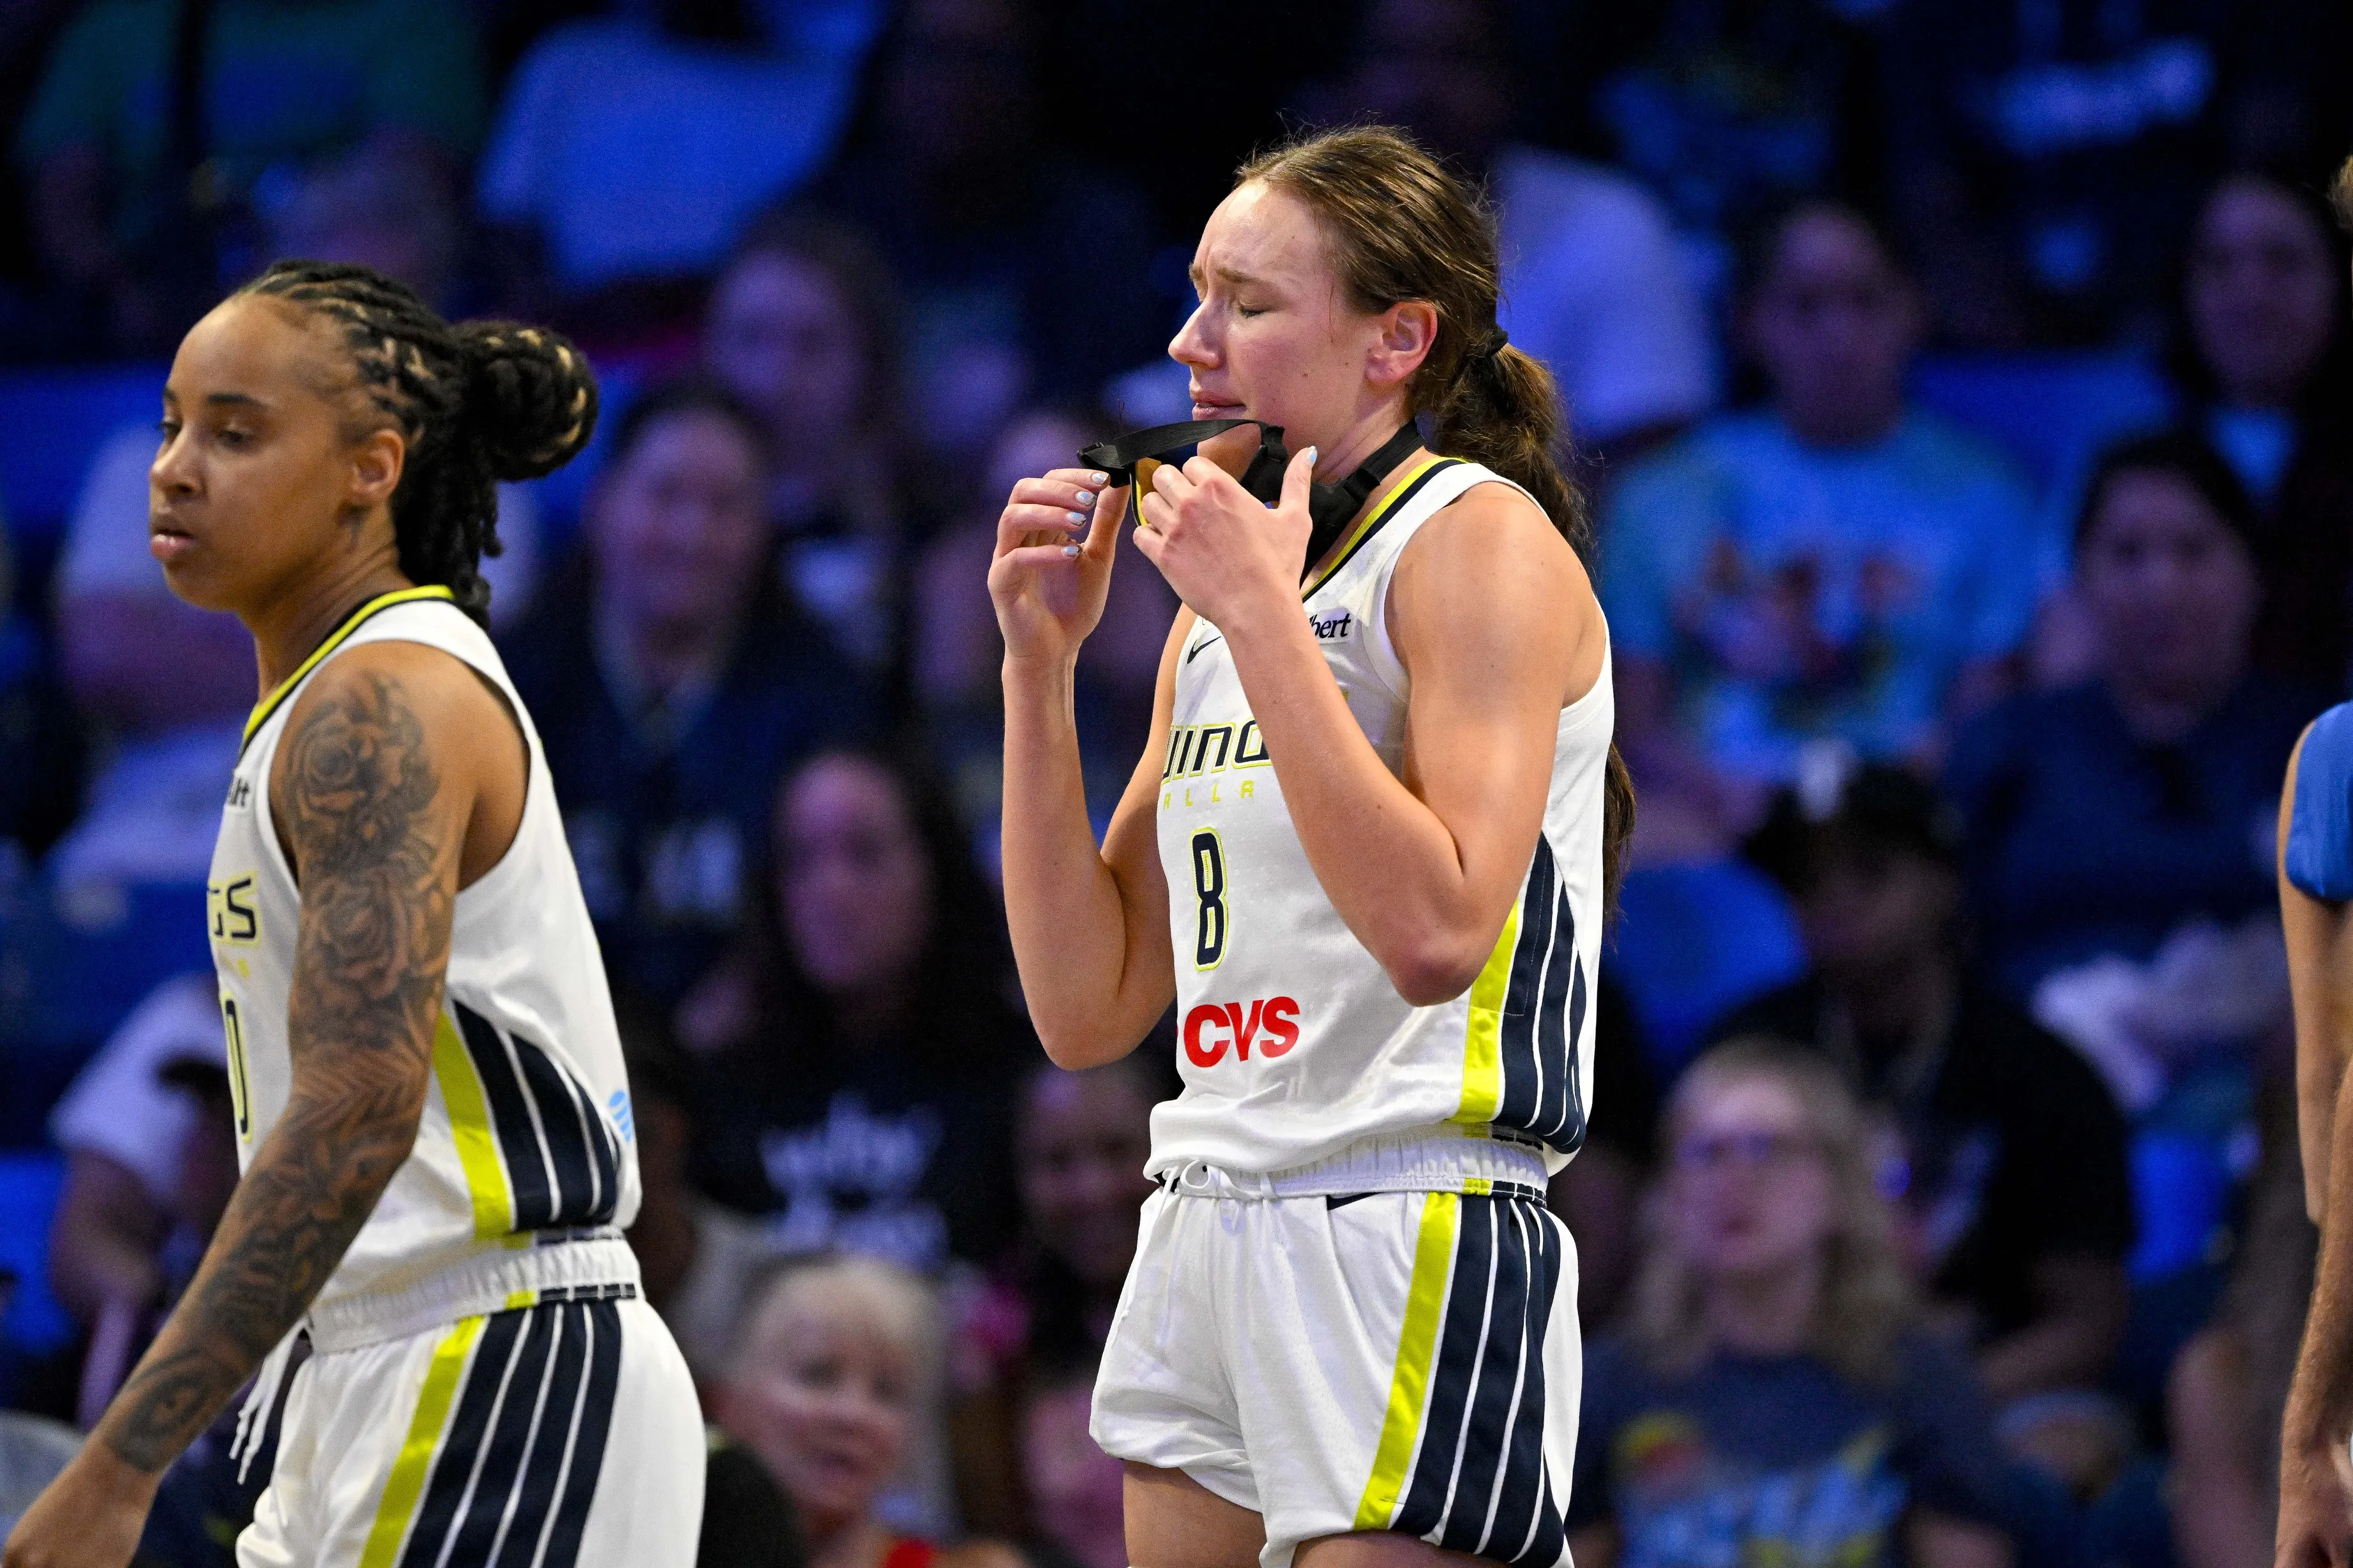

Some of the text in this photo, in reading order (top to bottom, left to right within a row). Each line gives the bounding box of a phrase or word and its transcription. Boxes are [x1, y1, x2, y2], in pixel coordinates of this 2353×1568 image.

[1309, 613, 1351, 639] bert
[1189, 826, 1229, 971] 8
[1184, 996, 1300, 1068] CVS
